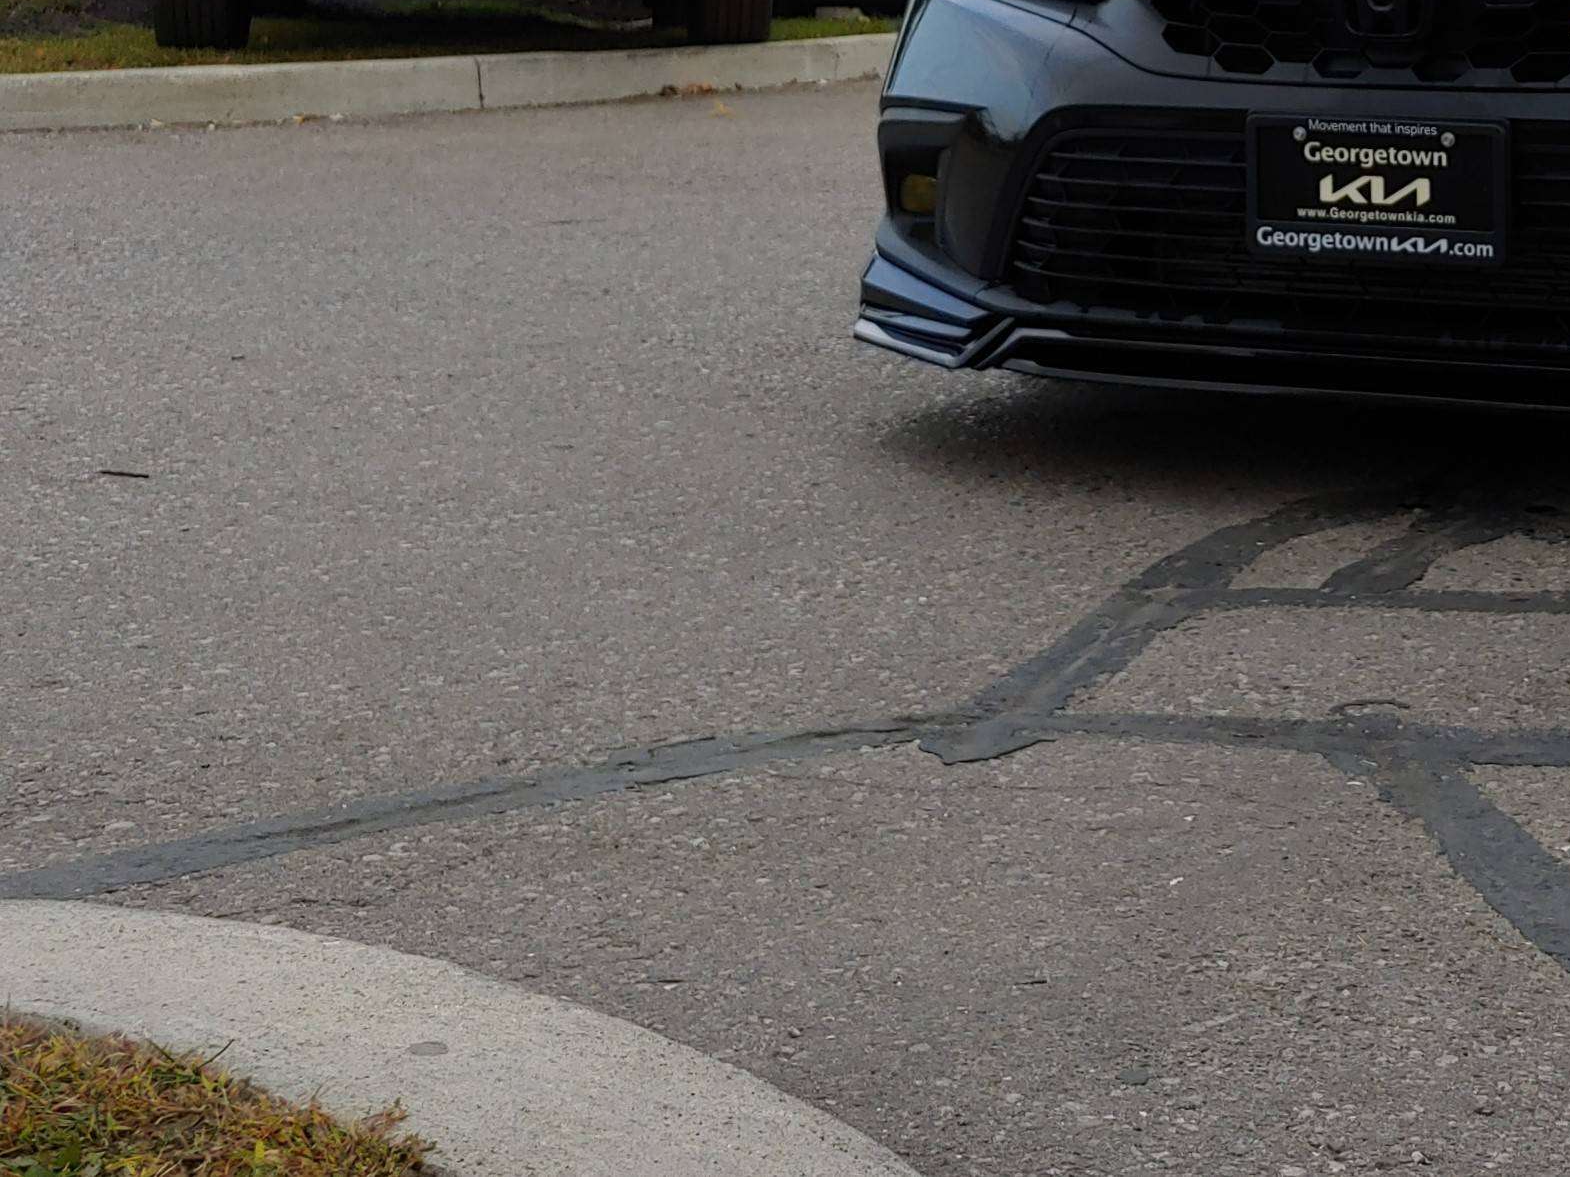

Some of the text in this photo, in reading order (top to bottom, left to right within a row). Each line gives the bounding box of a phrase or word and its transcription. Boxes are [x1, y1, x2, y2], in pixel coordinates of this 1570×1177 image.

[1308, 119, 1438, 137] Movement that inspires
[1303, 141, 1448, 168] Georgetown
[1319, 174, 1431, 207] KIA
[1296, 207, 1457, 224] www.Georgetownkia.com
